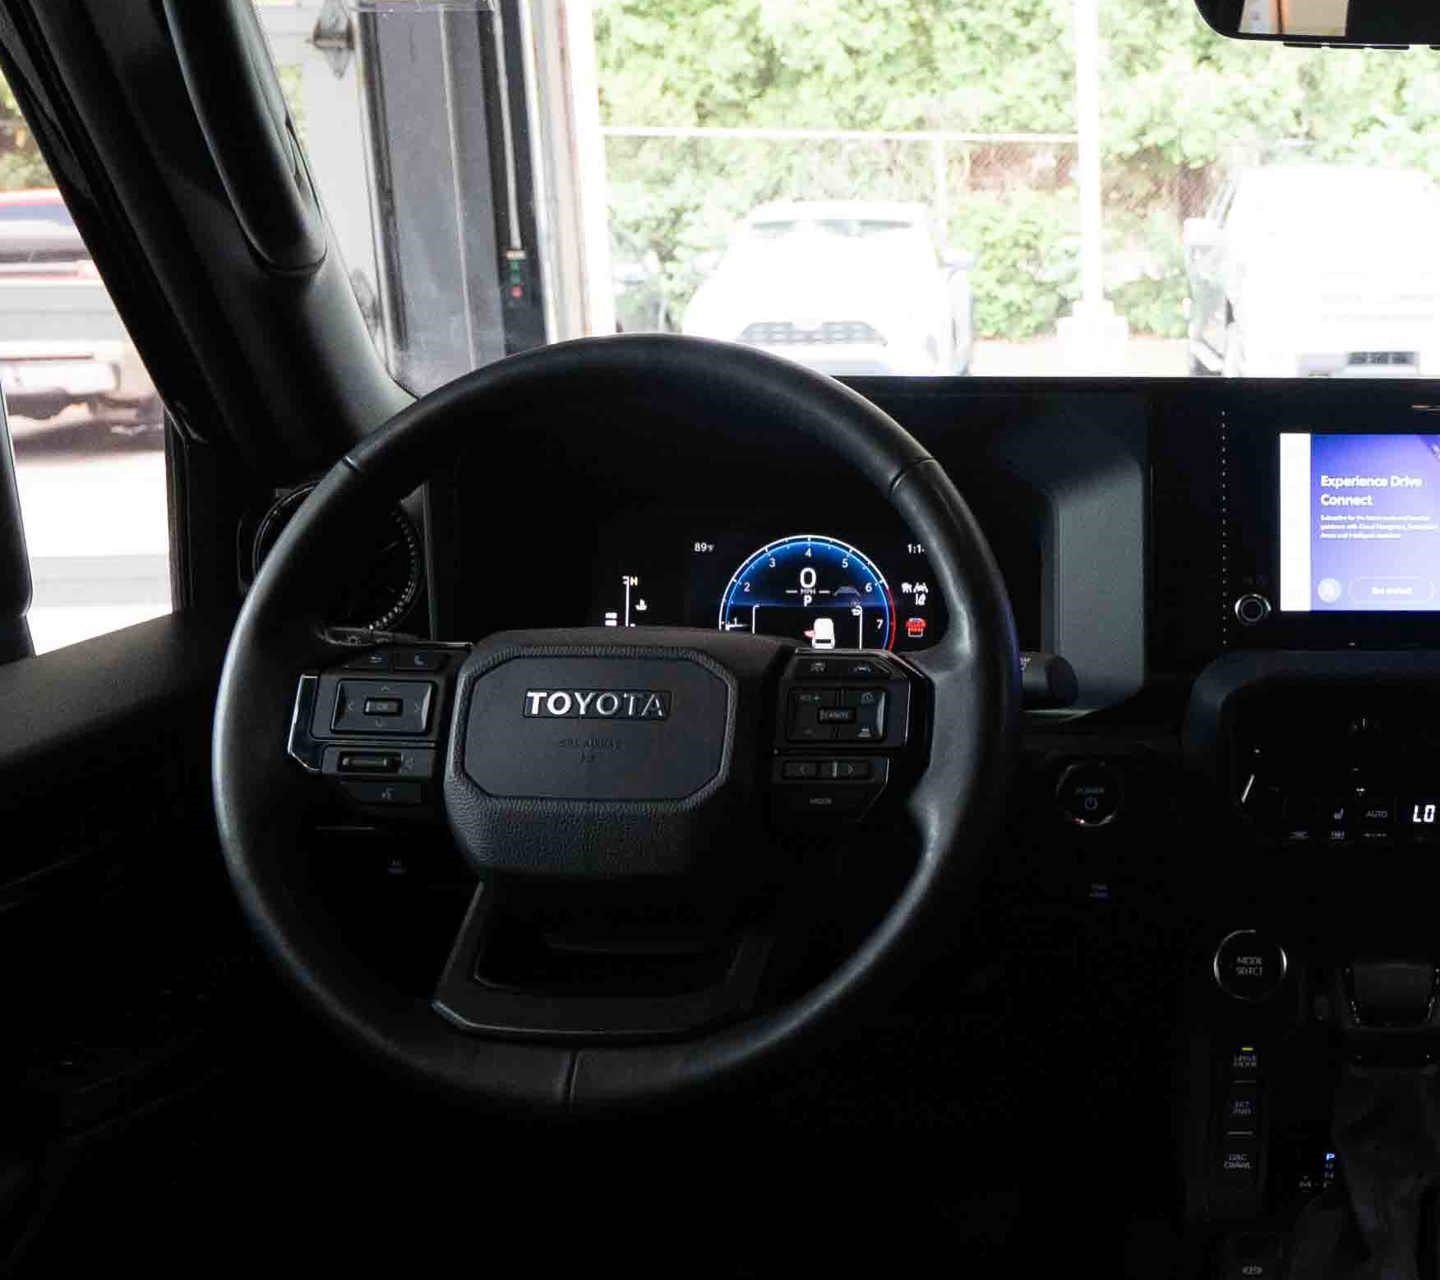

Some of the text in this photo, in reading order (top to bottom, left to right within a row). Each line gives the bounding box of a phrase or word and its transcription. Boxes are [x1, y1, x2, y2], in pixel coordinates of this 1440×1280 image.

[1320, 475, 1423, 488] Experience Drive
[1320, 494, 1373, 506] Connect
[804, 548, 812, 558] 4
[768, 558, 777, 568] 3
[841, 558, 849, 568] 5
[799, 567, 817, 588] 0
[743, 582, 751, 592] 2
[865, 582, 873, 592] 6
[803, 595, 813, 607] P
[876, 619, 884, 629] 7
[526, 691, 664, 717] TOYOTA
[1364, 810, 1391, 819] AUTO
